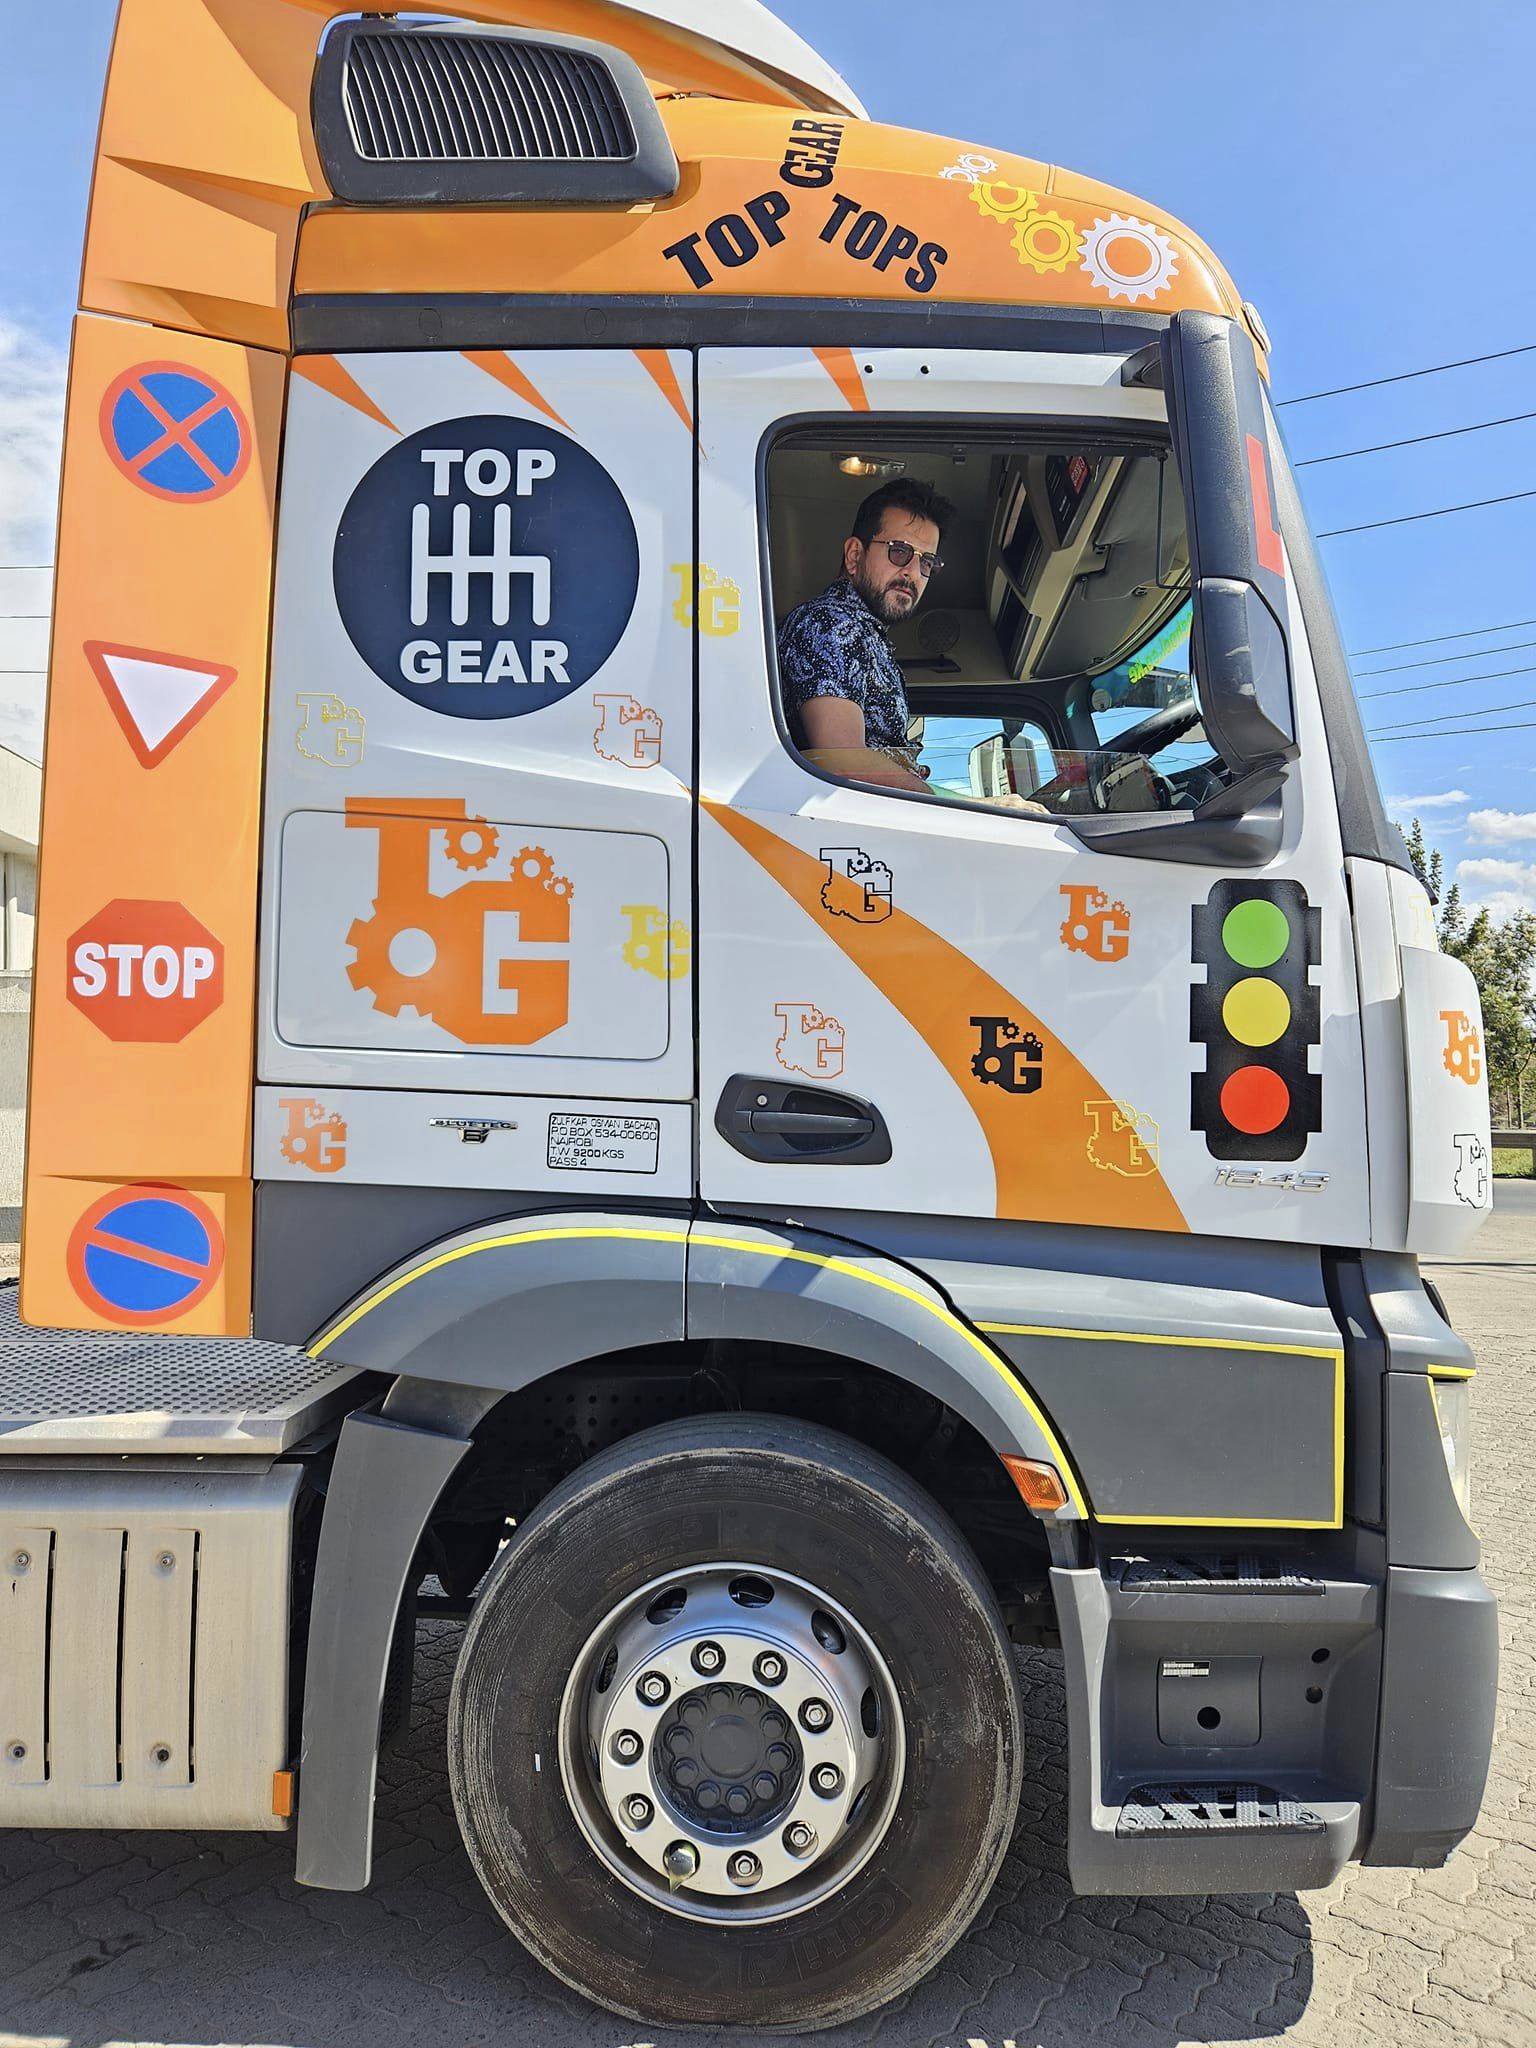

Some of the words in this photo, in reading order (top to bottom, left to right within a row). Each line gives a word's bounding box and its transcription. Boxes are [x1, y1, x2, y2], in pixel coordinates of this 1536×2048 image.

[779, 118, 845, 189] GEAR
[662, 190, 791, 289] TOP
[818, 193, 948, 293] TOPS
[421, 448, 556, 496] TOP
[399, 640, 571, 684] GEAR
[72, 942, 215, 999] STOP
[569, 1128, 593, 1137] BOX
[595, 1129, 657, 1140] 534-00600
[573, 1148, 601, 1158] 9200
[601, 1149, 625, 1159] KGS
[549, 1156, 578, 1167] PASS
[579, 1158, 587, 1167] 4
